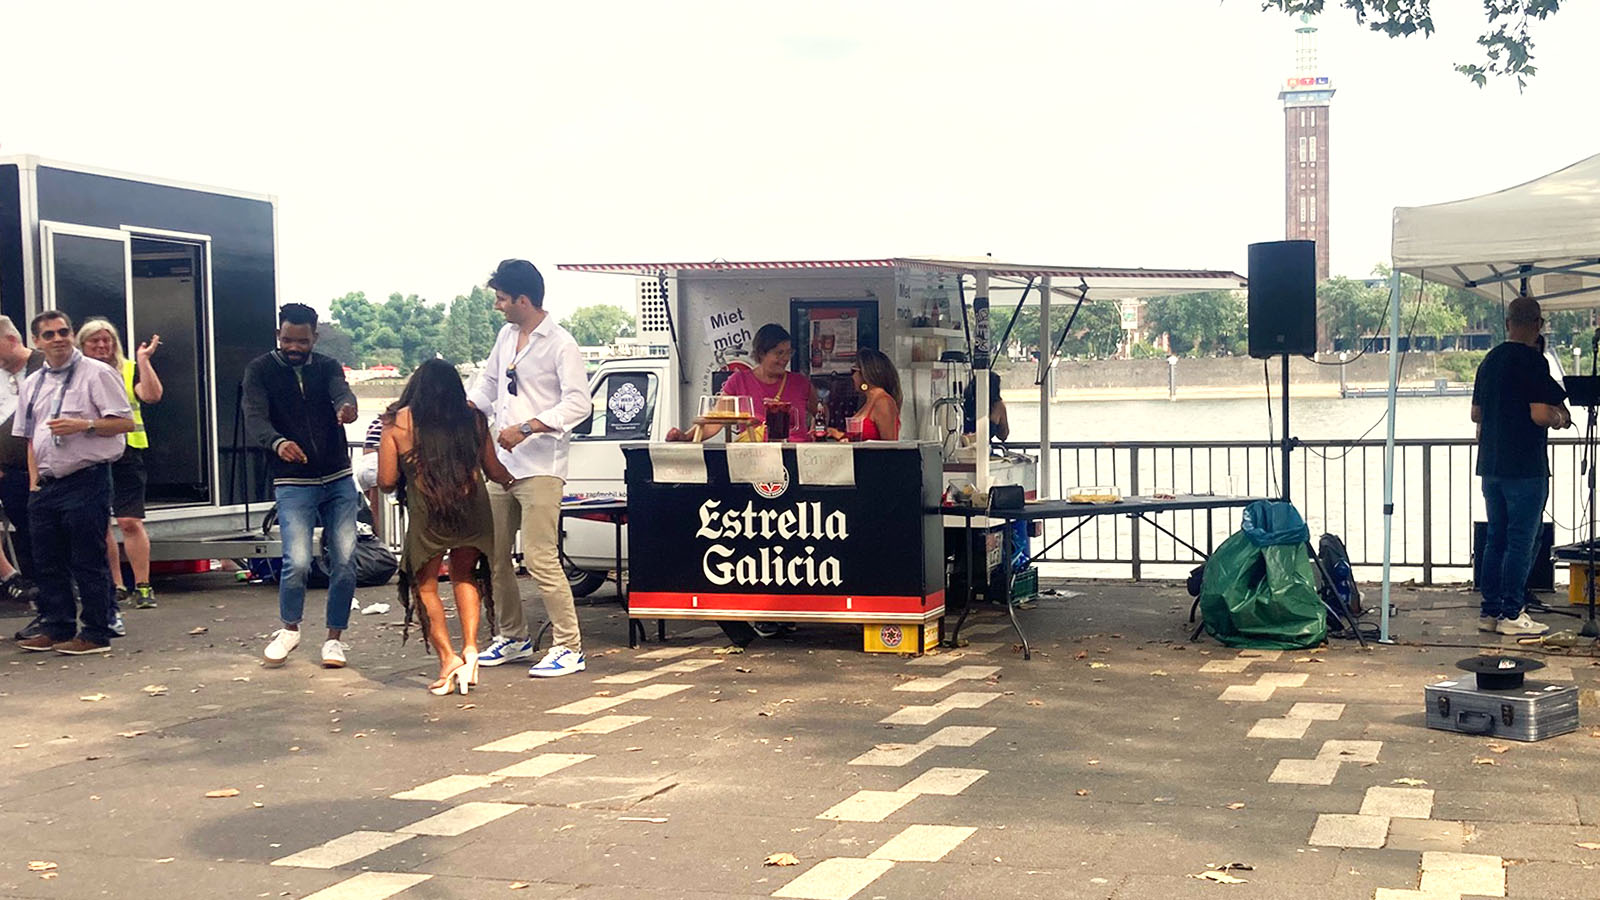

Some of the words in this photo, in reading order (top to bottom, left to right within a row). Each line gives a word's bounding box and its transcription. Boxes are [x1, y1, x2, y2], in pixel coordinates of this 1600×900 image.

[710, 307, 745, 330] Miet
[714, 328, 752, 351] mich
[695, 498, 850, 541] Estrella
[702, 543, 844, 587] Galicia
